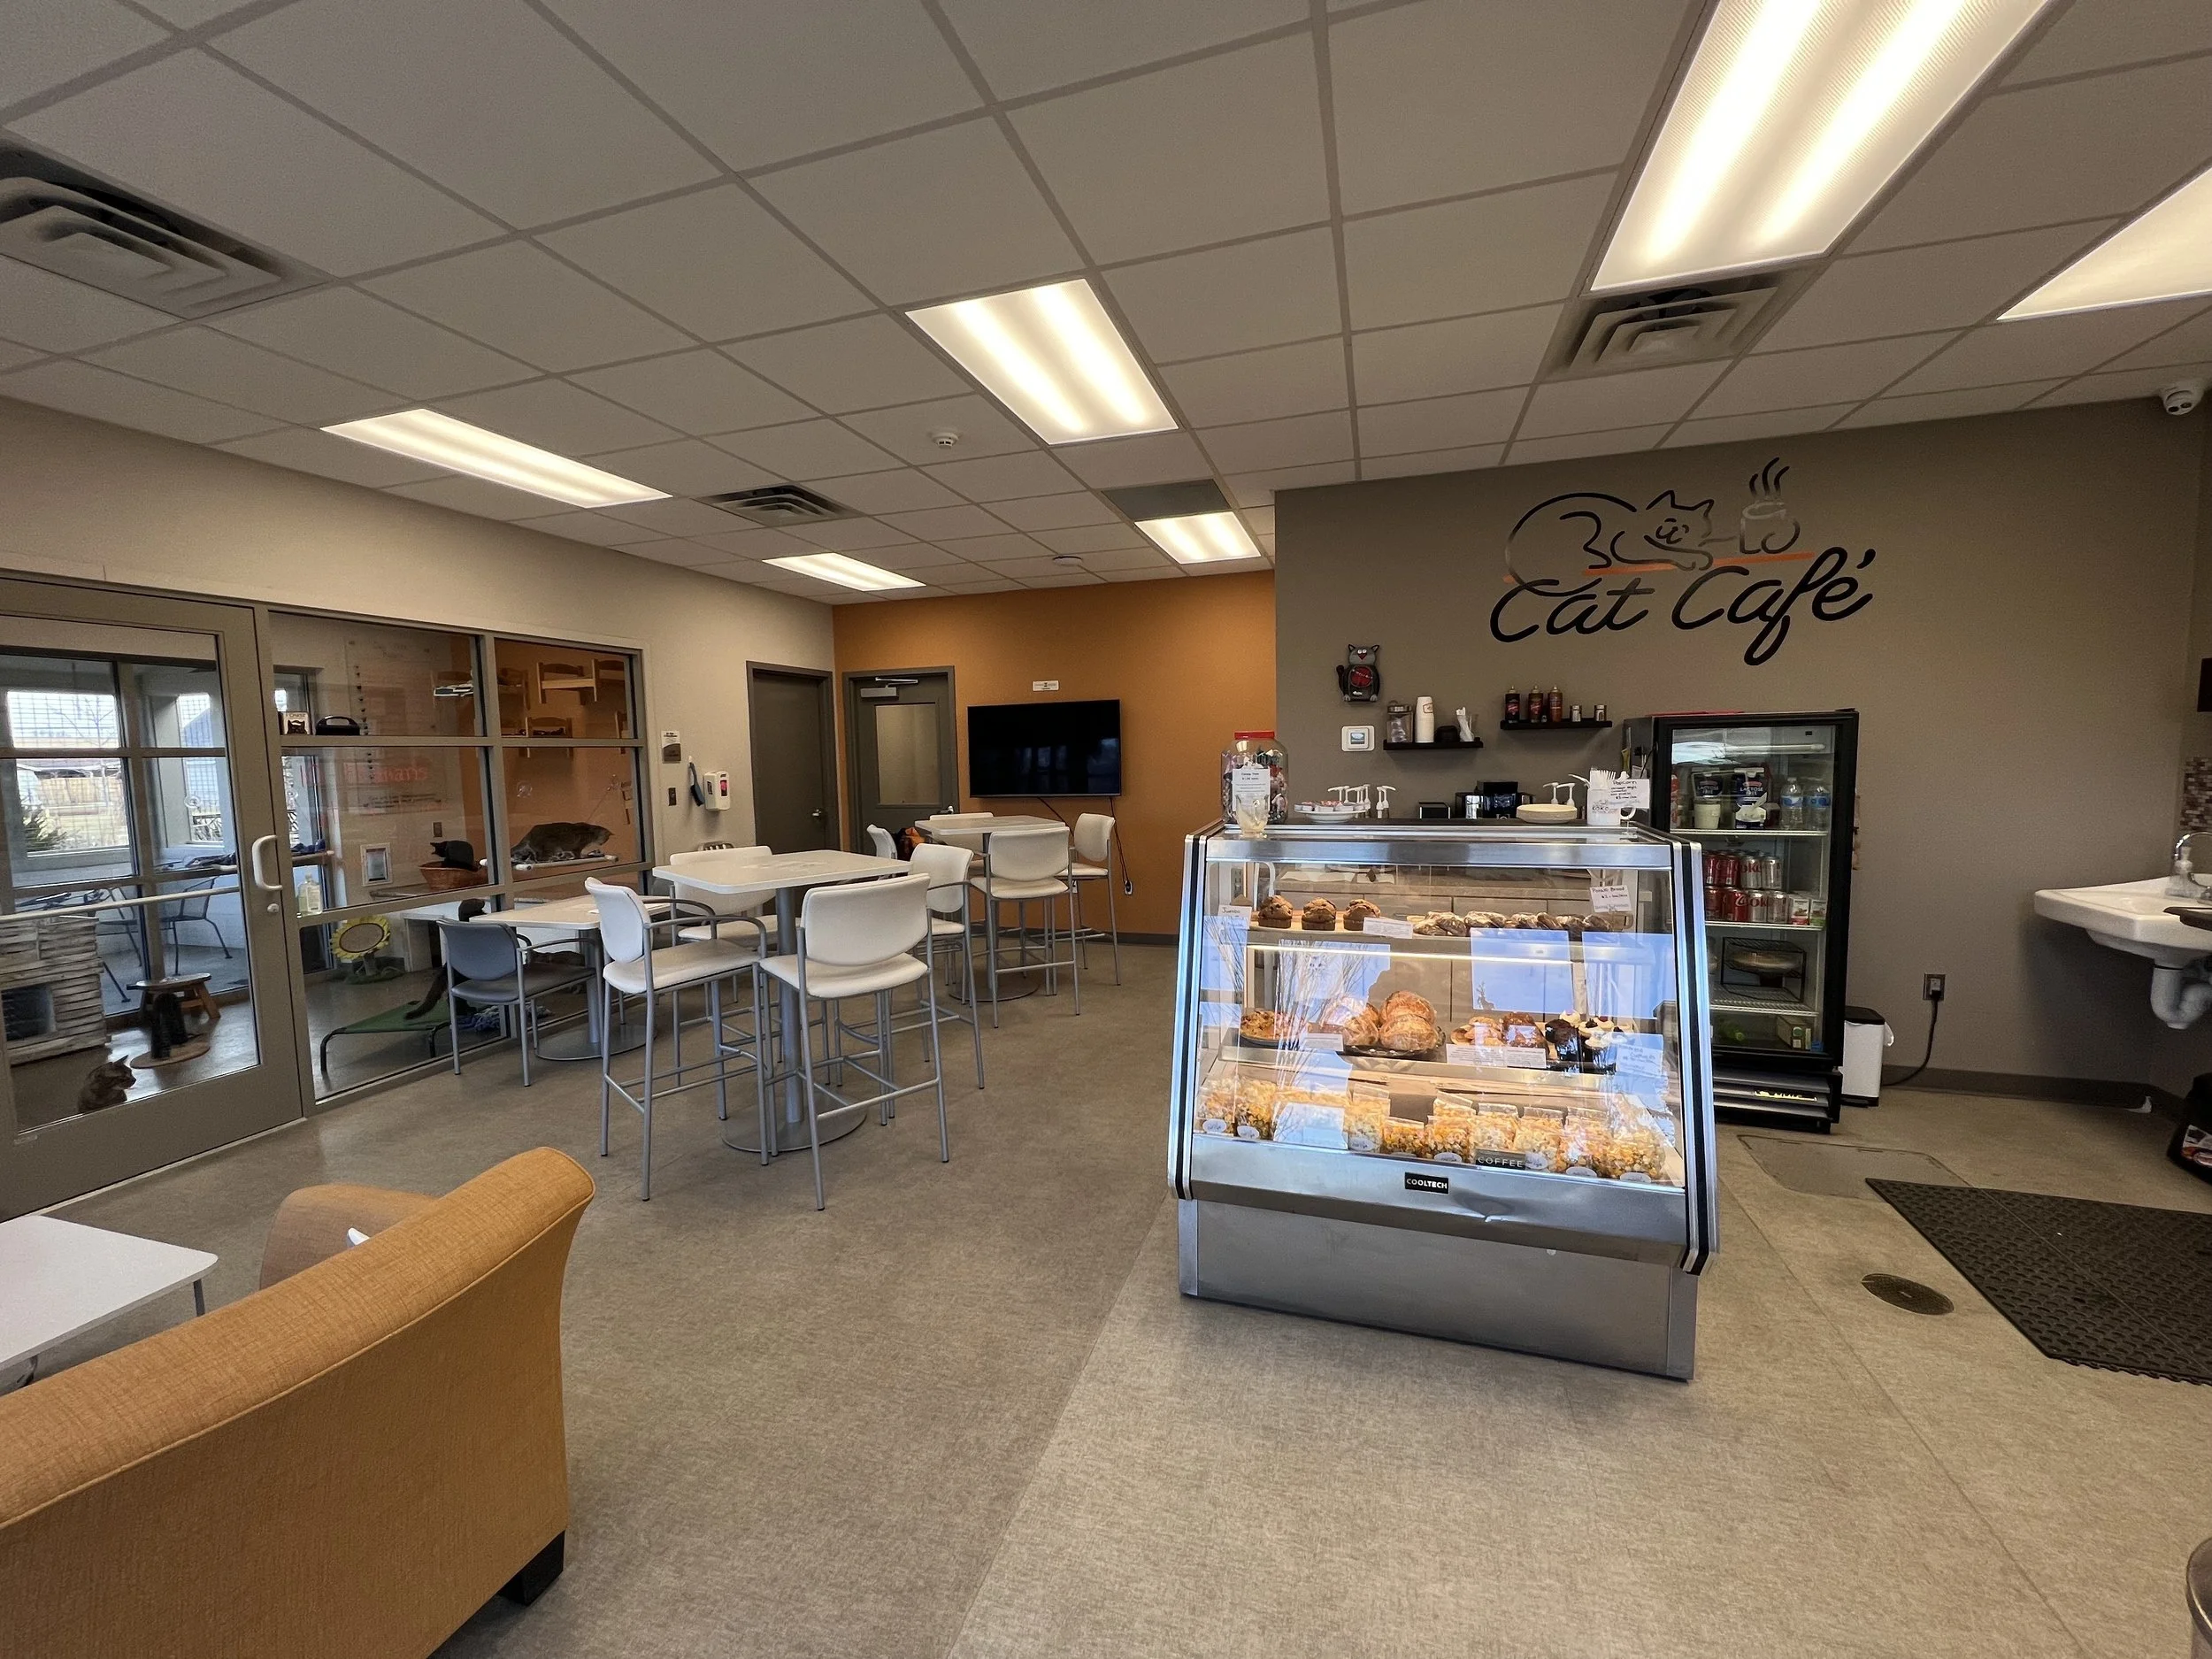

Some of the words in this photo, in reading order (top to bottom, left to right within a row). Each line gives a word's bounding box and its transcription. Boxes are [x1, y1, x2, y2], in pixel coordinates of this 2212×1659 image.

[1490, 577, 1655, 643] Cat
[1671, 546, 1877, 666] Café
[1478, 1156, 1524, 1168] COFFEE
[1406, 1178, 1448, 1189] COOLTECH
